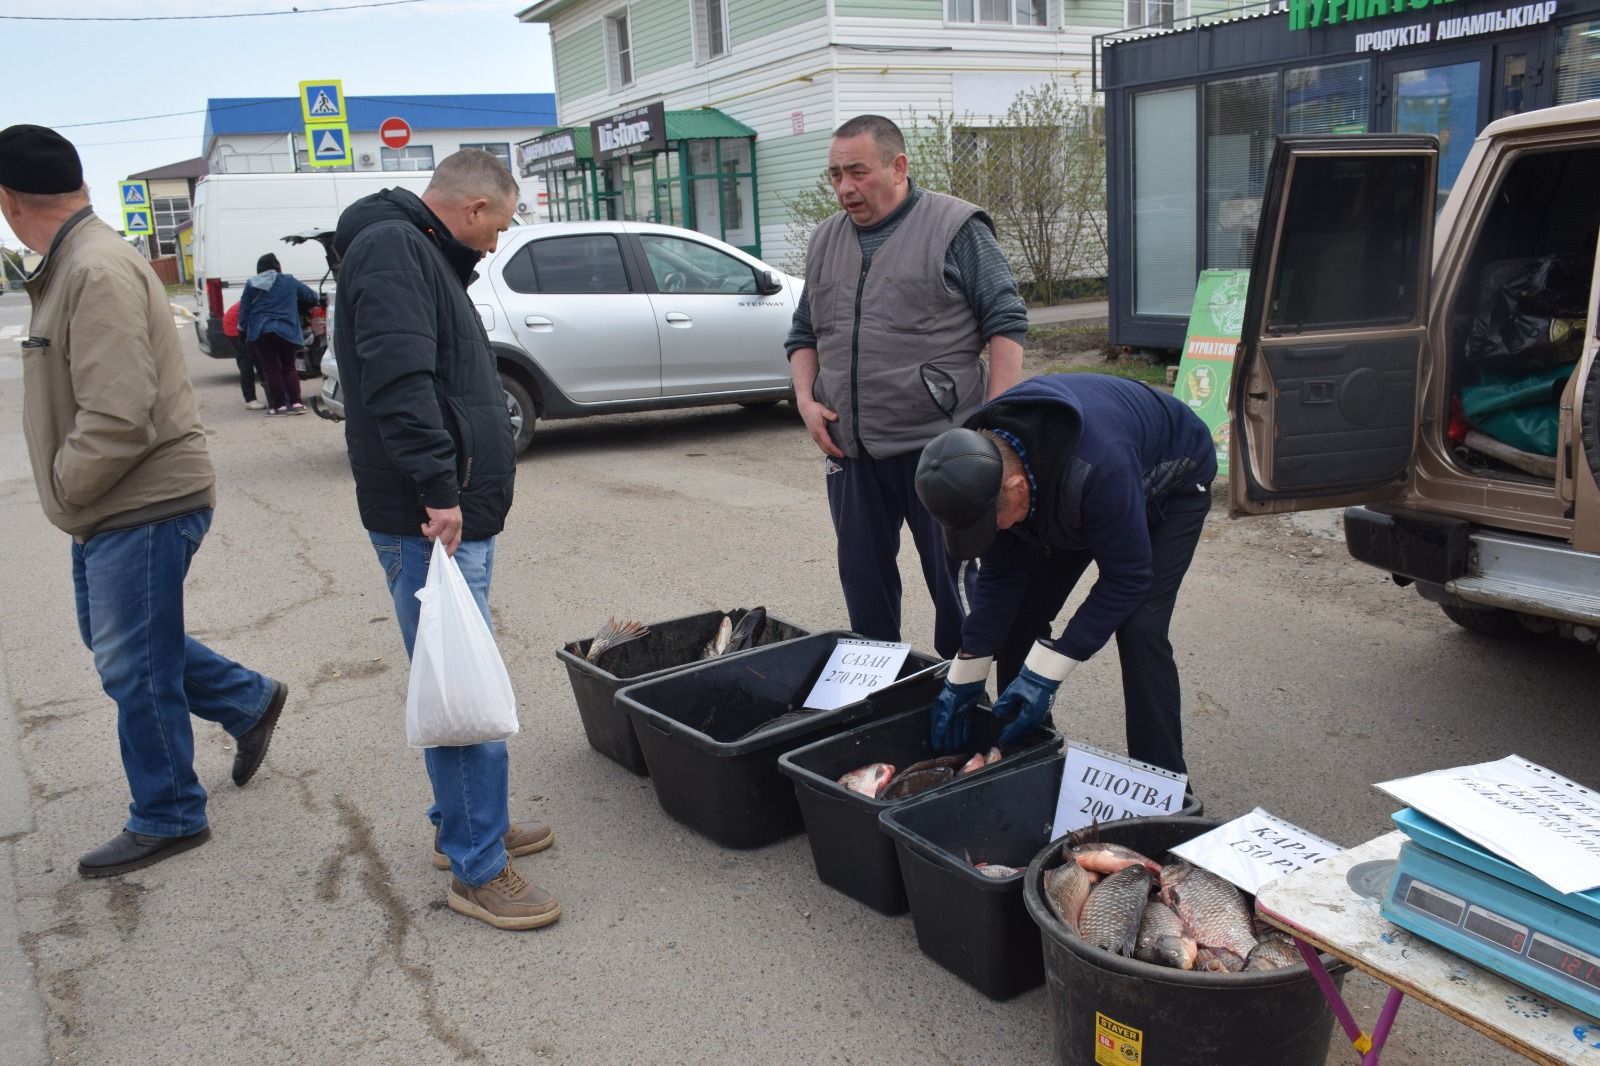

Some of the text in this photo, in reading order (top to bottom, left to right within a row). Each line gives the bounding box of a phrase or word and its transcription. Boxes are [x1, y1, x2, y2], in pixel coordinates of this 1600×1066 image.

[1355, 1, 1557, 53] ПРОДУКТЫ АШАМЛЫКЛАР
[841, 652, 892, 669] САЗАН
[825, 670, 882, 688] 270 РУБ
[1081, 766, 1173, 812] ПЛОТВА
[1080, 796, 1114, 821] 200
[1228, 839, 1273, 859] 150
[1512, 933, 1525, 949] 0
[1100, 1018, 1137, 1040] STAYER
